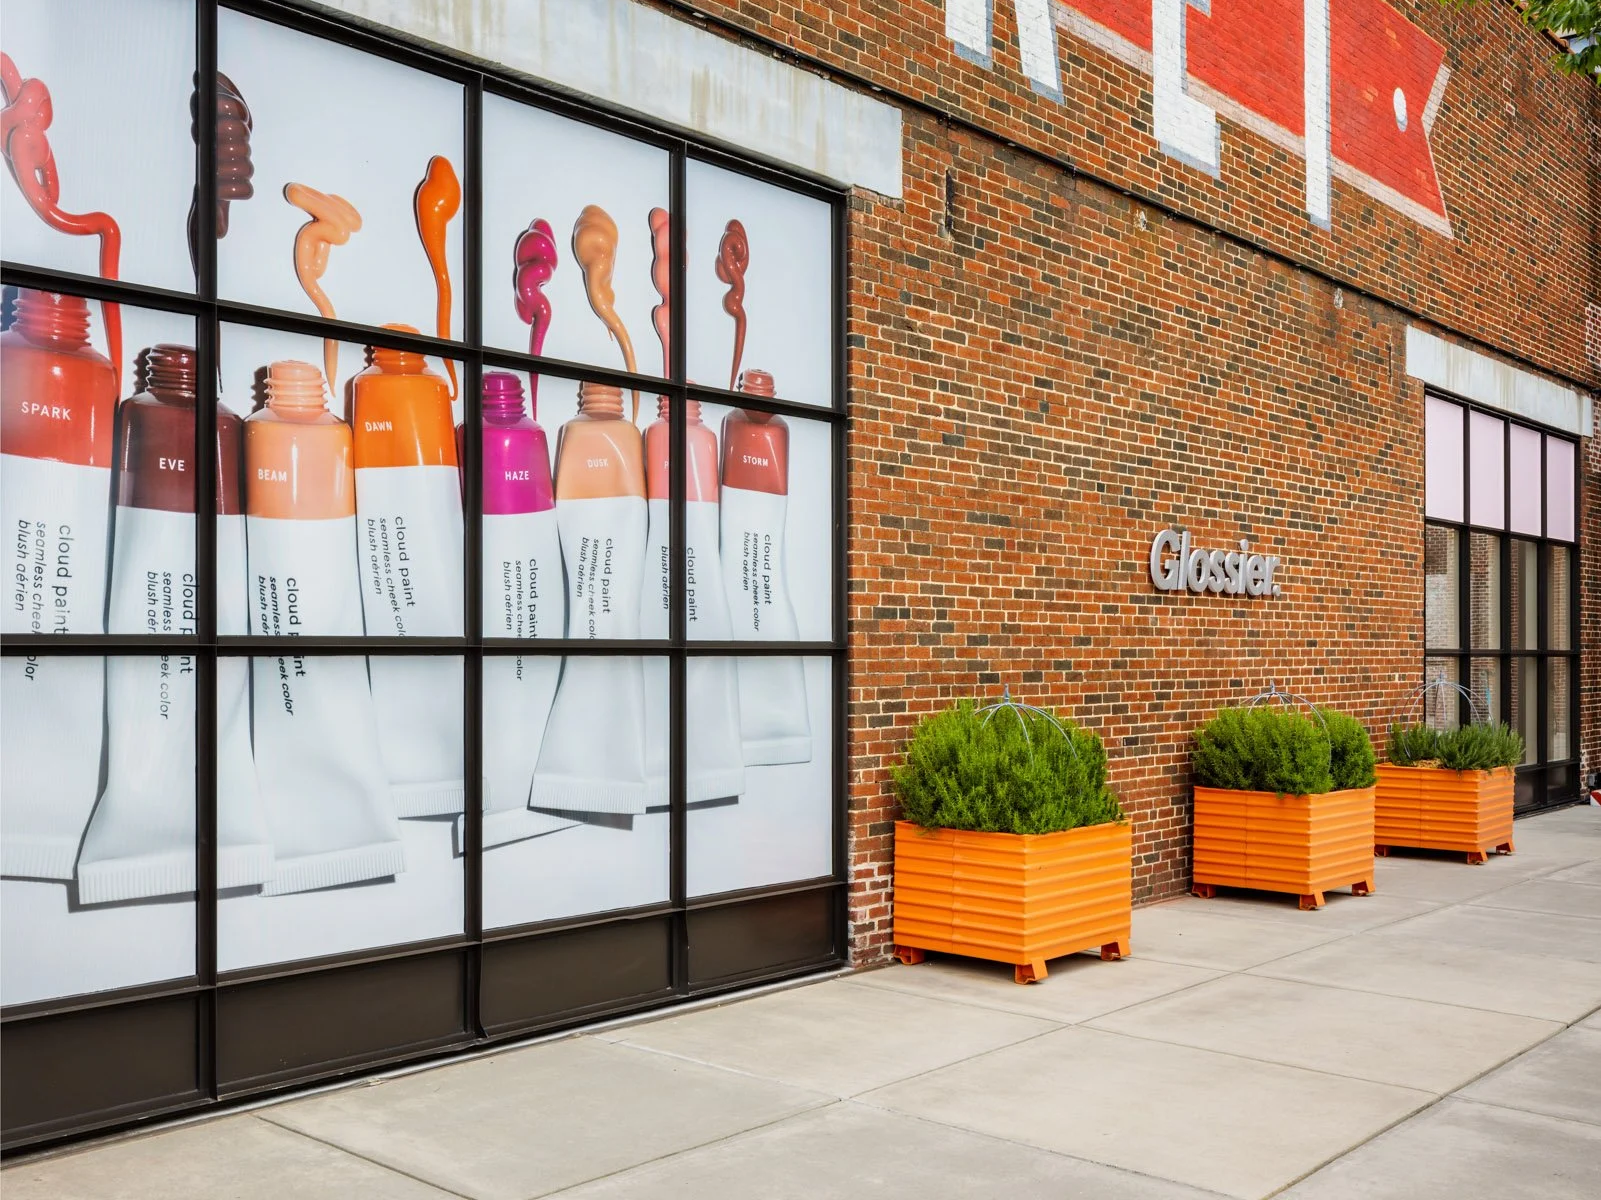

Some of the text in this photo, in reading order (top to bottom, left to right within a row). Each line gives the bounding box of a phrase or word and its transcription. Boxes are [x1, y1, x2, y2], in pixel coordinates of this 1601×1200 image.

[21, 401, 72, 421] SPARK
[365, 421, 393, 432] DAWN
[159, 457, 185, 471] EVE
[258, 469, 287, 482] BEAM
[505, 471, 530, 481] HAZE
[586, 458, 609, 468] DUSK
[743, 455, 769, 467] STORM
[15, 519, 31, 611] blush aérien
[33, 521, 47, 589] seamless
[367, 518, 382, 595] blush aérien
[380, 517, 391, 574] seamless
[386, 577, 401, 613] cheek
[395, 516, 416, 607] cloud paint
[580, 537, 590, 562] blush
[661, 545, 669, 574] blush
[762, 534, 772, 605] cloud paint
[1150, 529, 1281, 597] Glossier.
[52, 524, 74, 634] cloud paint
[147, 571, 159, 605] blush
[183, 573, 200, 620] cloud
[258, 575, 268, 610] blush
[503, 561, 513, 591] blush
[515, 560, 524, 611] seamless
[527, 558, 539, 638] cloud paint
[588, 538, 600, 640] seamless cheek colo
[601, 538, 614, 614] cloud paint
[686, 547, 698, 621] cloud paint
[752, 579, 760, 606] cheek
[163, 571, 174, 632] seamless
[286, 577, 302, 625] cloud
[753, 607, 761, 632] color
[269, 576, 281, 636] seamless
[281, 682, 294, 716] color
[160, 682, 171, 720] color
